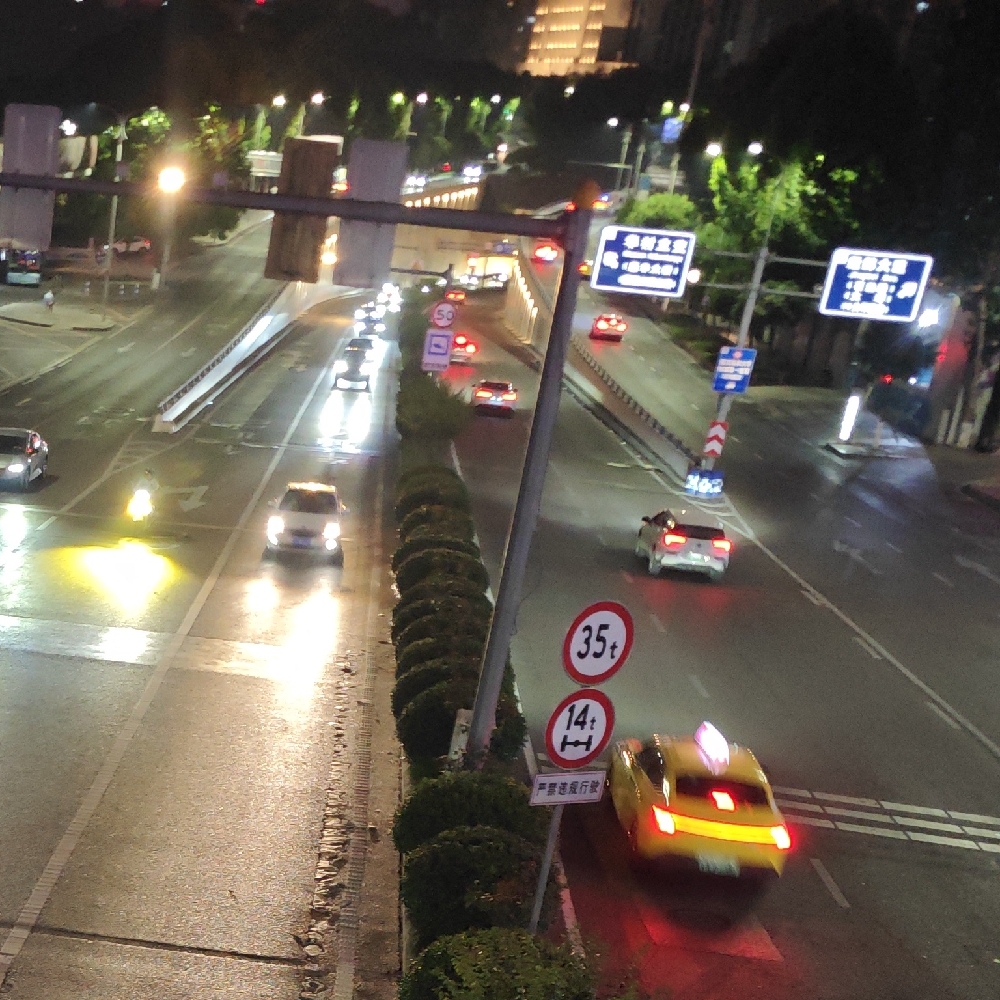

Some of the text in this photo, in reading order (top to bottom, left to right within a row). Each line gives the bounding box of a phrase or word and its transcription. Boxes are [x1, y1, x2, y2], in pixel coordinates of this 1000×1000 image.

[437, 309, 455, 321] 50
[576, 623, 618, 660] 35t
[565, 703, 597, 731] 14t
[536, 780, 600, 797] 严禁违规行驶
